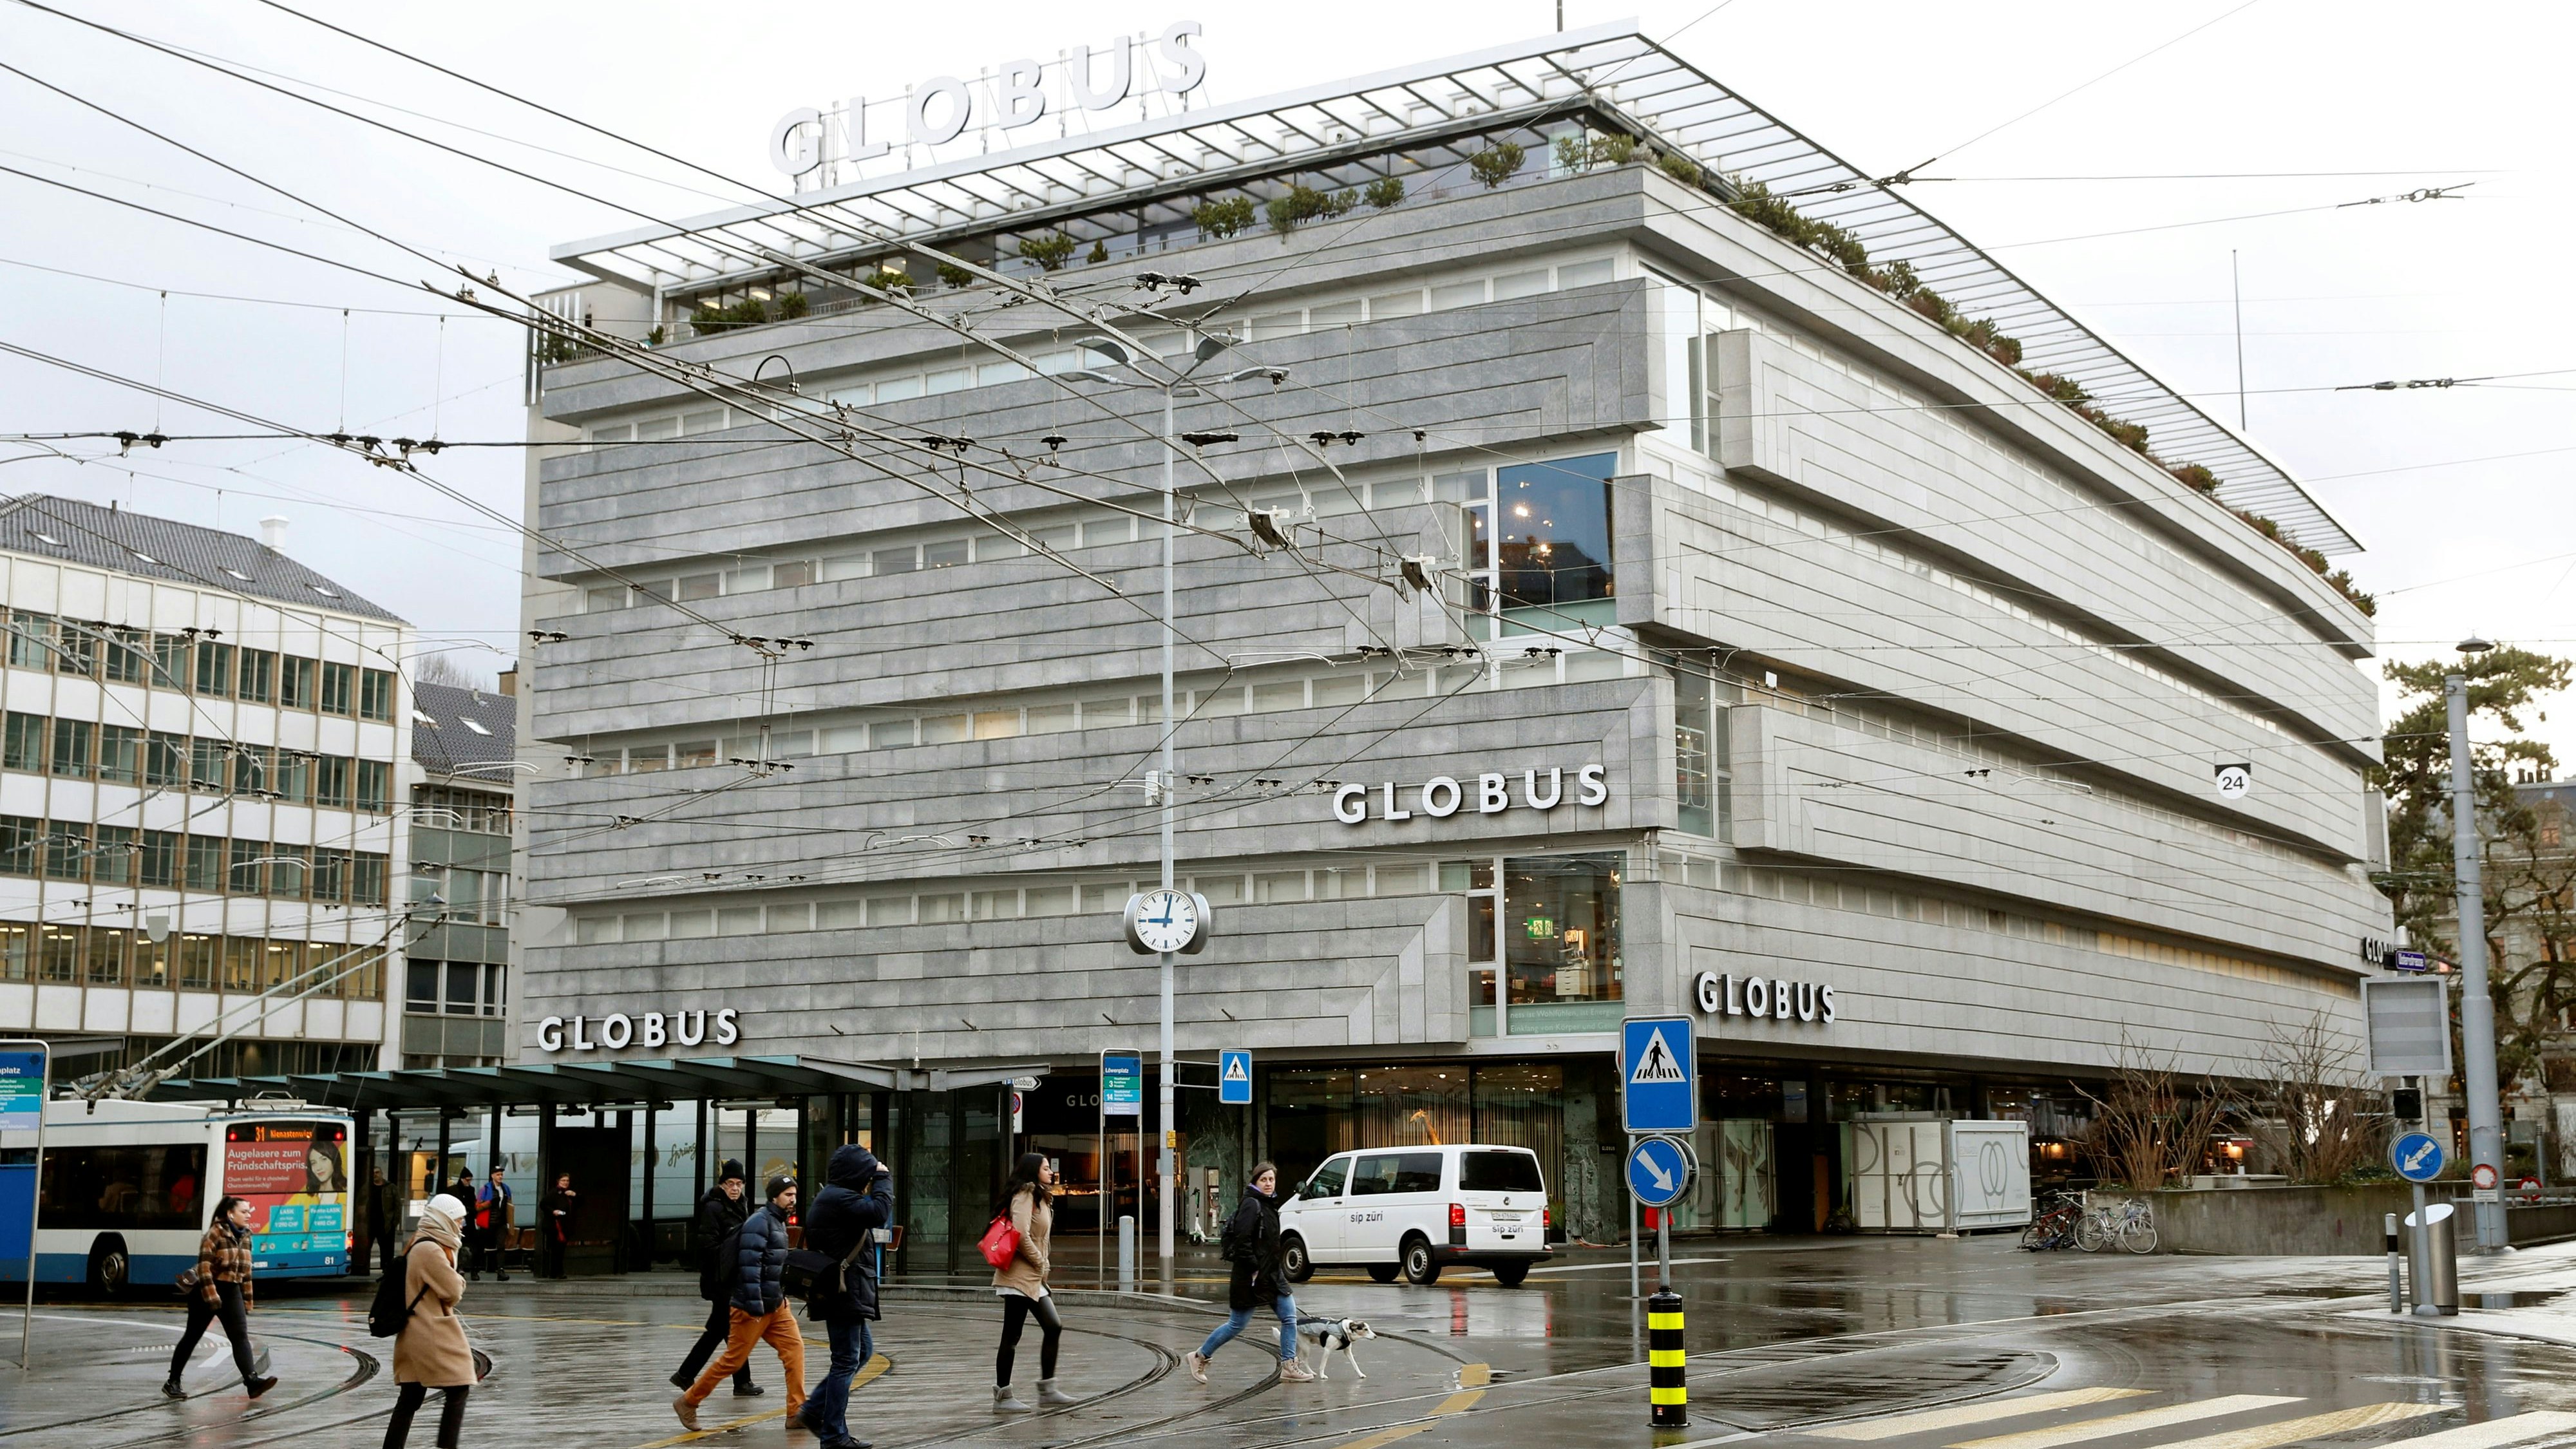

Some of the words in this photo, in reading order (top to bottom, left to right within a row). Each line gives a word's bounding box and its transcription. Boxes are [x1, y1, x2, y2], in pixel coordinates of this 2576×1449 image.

[770, 20, 1206, 176] GLOBUS
[2222, 776, 2244, 790] 24
[1333, 764, 1609, 824] GLOBUS
[2363, 936, 2394, 963] GLO
[1694, 971, 1835, 1024] GLOBUS
[537, 1009, 739, 1052] GLOBUS
[1014, 1078, 1032, 1086] Globus
[1066, 1095, 1100, 1106] GLO
[255, 1126, 265, 1142] 31
[228, 1149, 279, 1160] Augelasere
[228, 1160, 308, 1171] Fründschaftspriis.
[1350, 1211, 1363, 1224] sip
[1492, 1225, 1505, 1234] sip
[325, 1256, 334, 1265] 81
